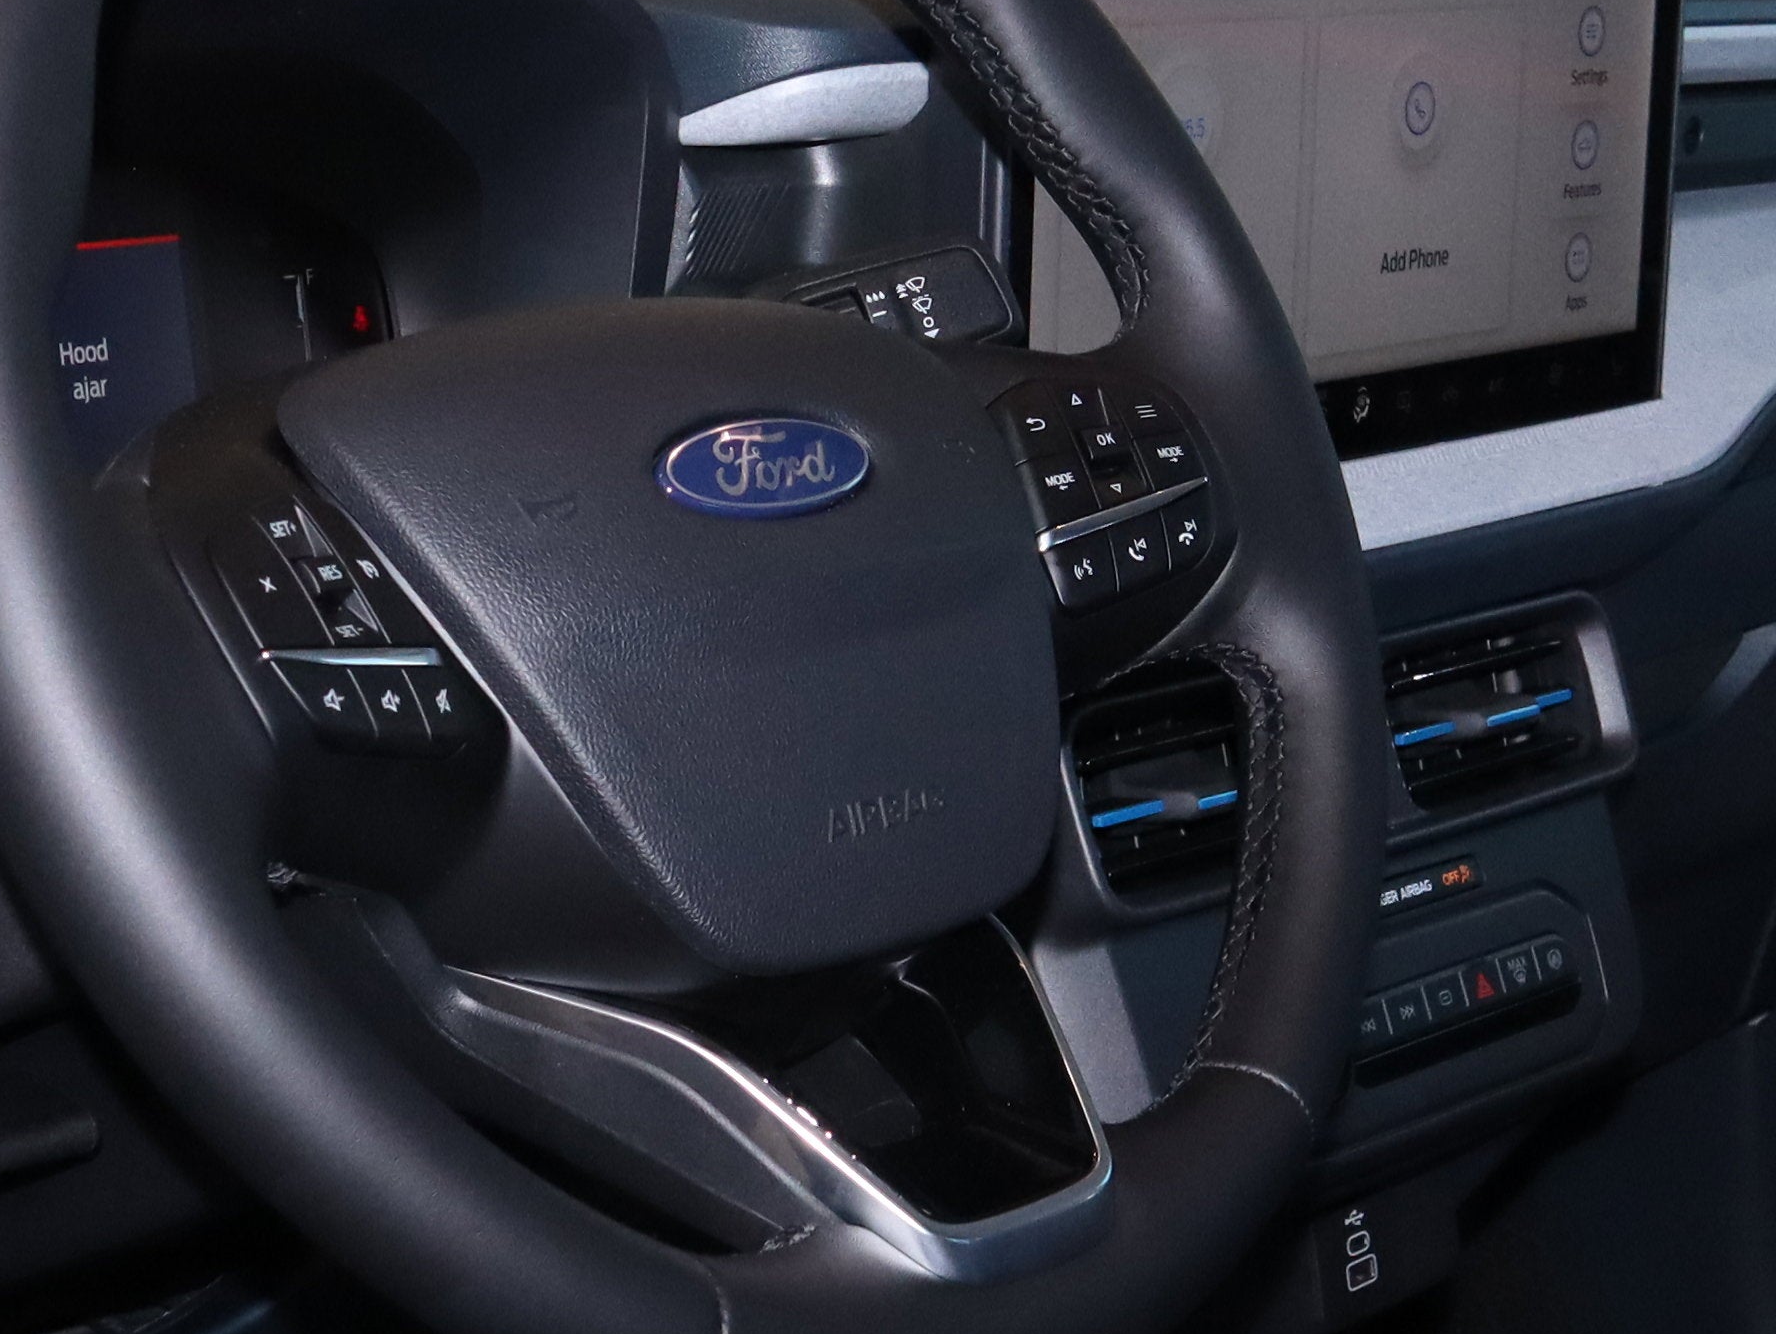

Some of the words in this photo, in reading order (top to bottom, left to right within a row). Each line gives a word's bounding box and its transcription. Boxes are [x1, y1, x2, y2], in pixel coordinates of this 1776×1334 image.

[1570, 68, 1609, 87] Settings
[1563, 182, 1602, 200] Features
[1379, 250, 1407, 275] Add
[1408, 247, 1450, 271] Phone
[1566, 294, 1588, 312] Apps
[58, 336, 109, 367] Hood
[72, 375, 108, 404] ajar
[1096, 432, 1117, 447] OK
[1156, 445, 1185, 460] MODE
[711, 428, 837, 497] Ford
[1044, 471, 1076, 488] MODE
[269, 519, 297, 539] SET+
[317, 564, 343, 582] RES
[1400, 878, 1433, 901] AIRBAG
